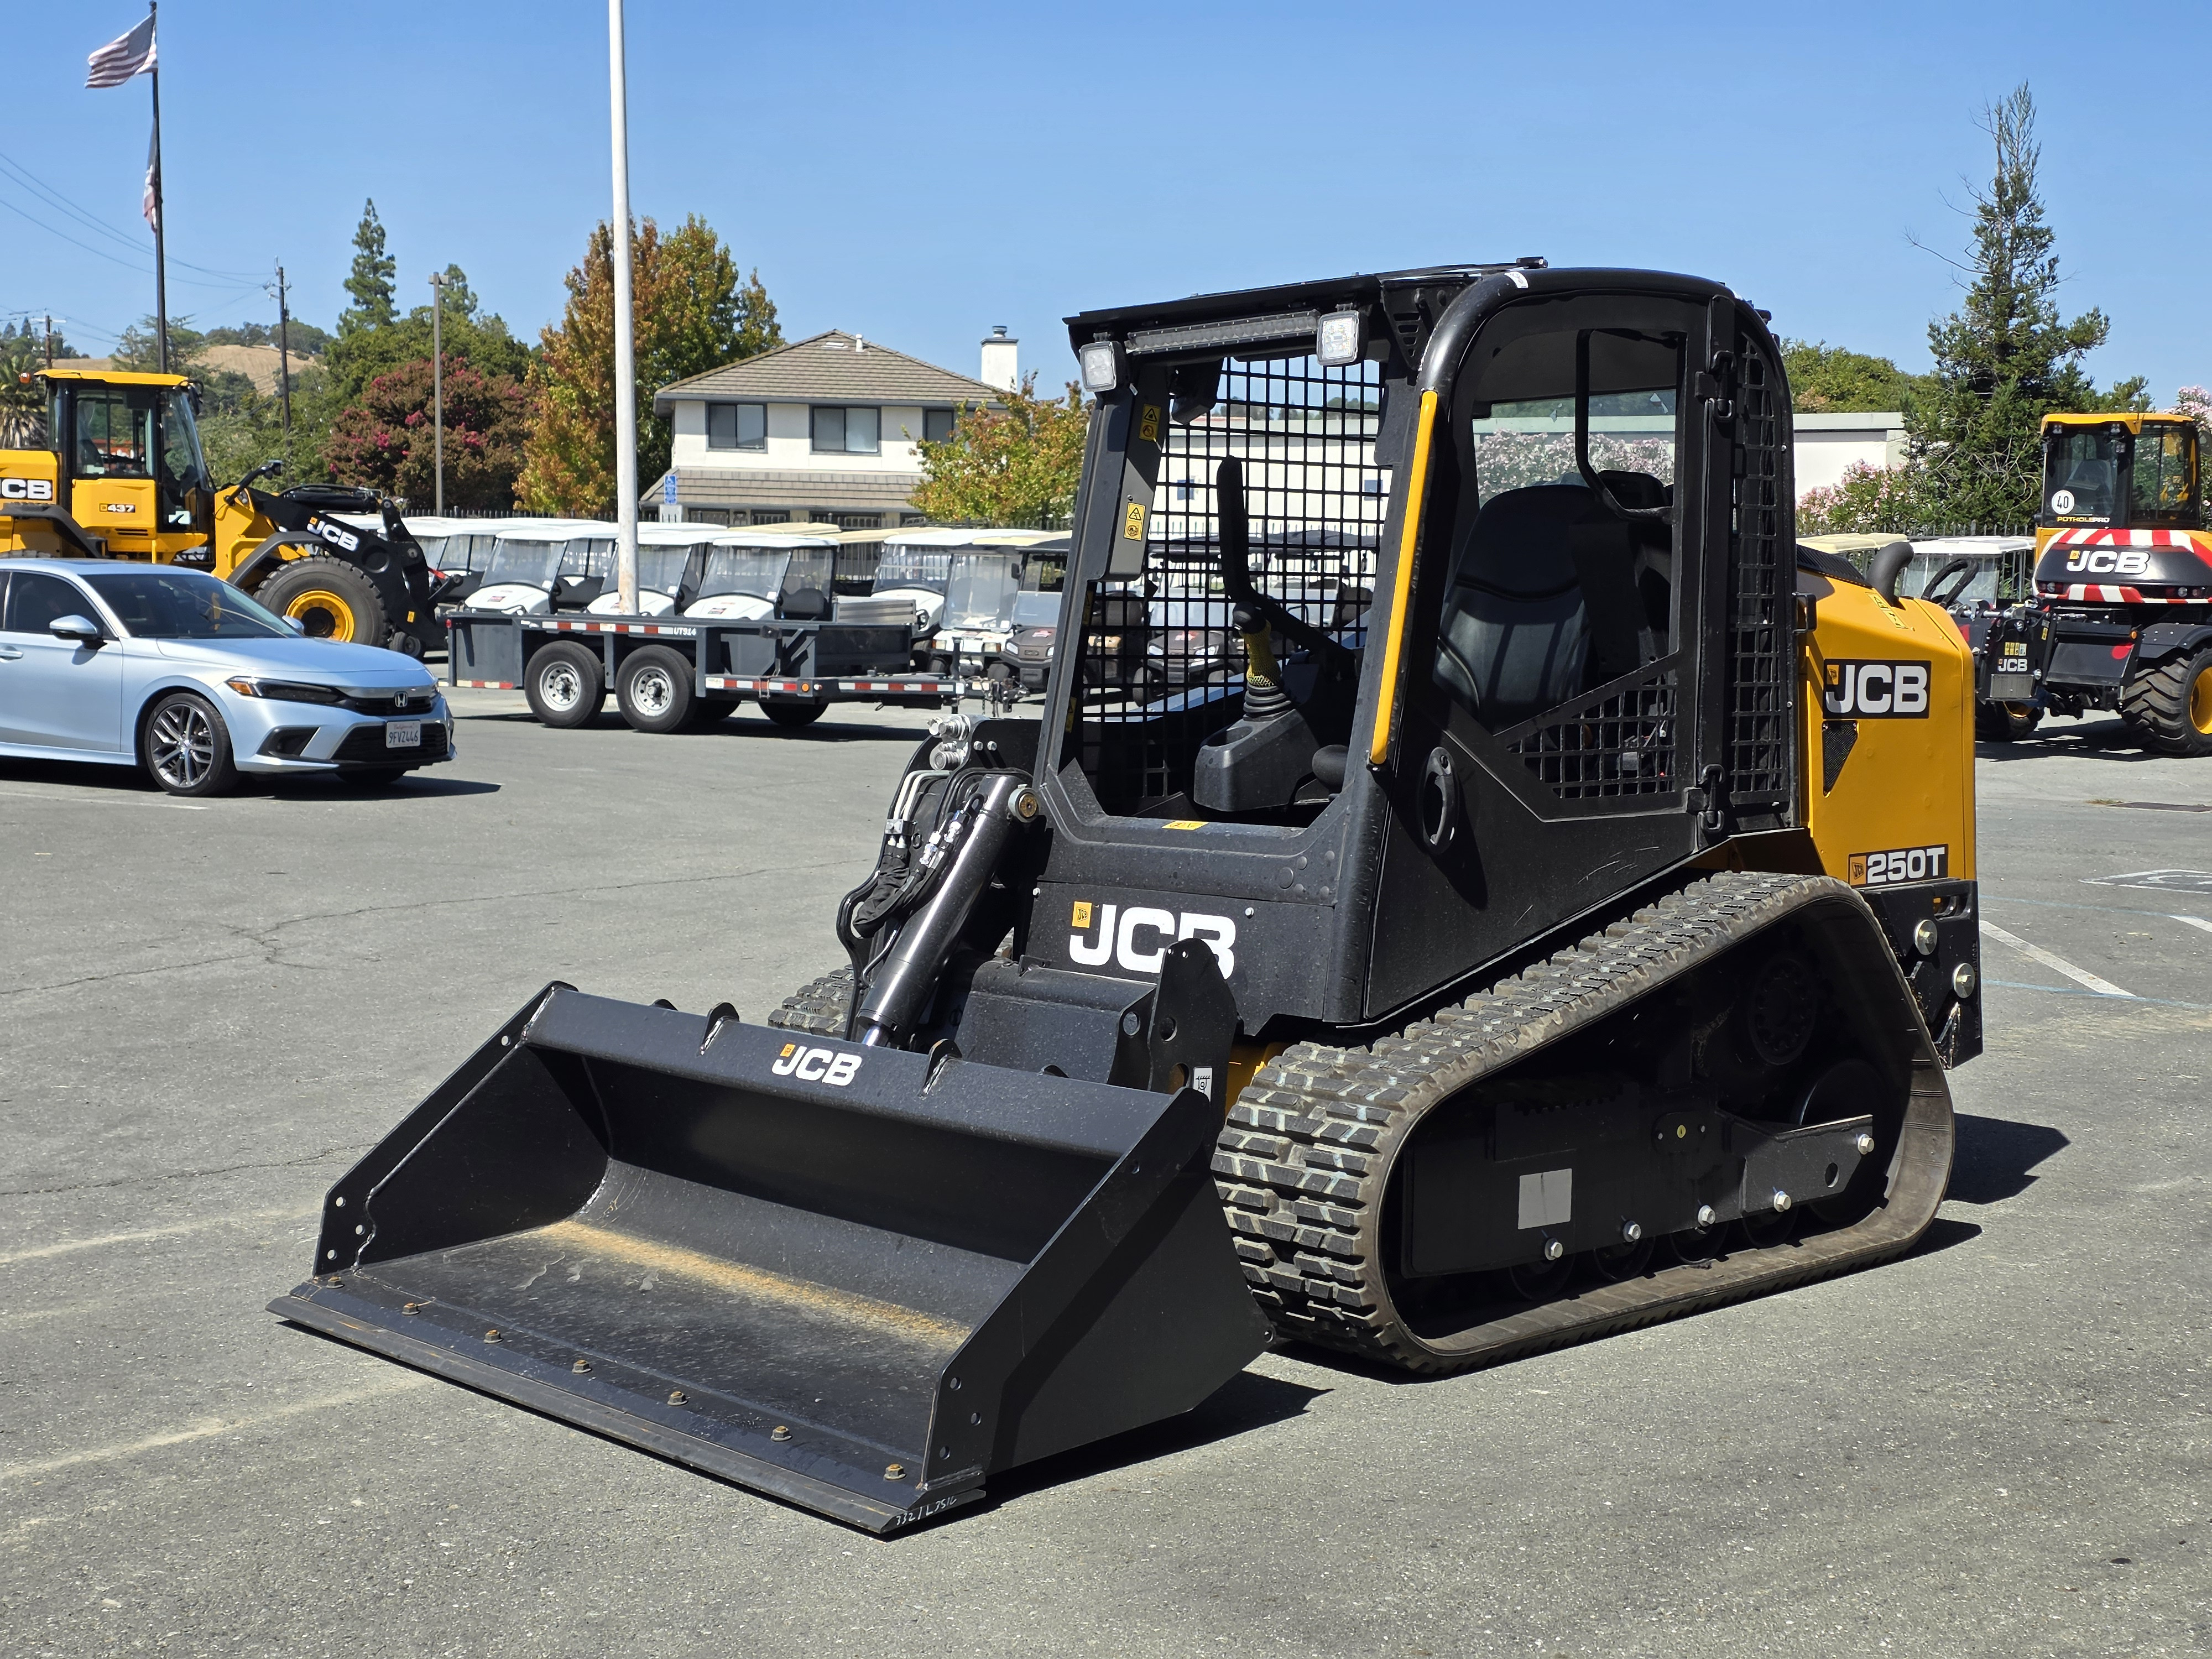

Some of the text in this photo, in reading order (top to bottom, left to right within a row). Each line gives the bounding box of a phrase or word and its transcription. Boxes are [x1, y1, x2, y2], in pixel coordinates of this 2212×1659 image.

[0, 479, 51, 499] CB
[2057, 496, 2069, 508] 40
[307, 520, 359, 551] JCB
[2067, 550, 2150, 574] JCB
[1998, 659, 2027, 671] JCB
[1826, 665, 1927, 713] JCB
[1867, 847, 1945, 884] 250T
[1070, 904, 1236, 979] JCB
[772, 1046, 862, 1086] JCB
